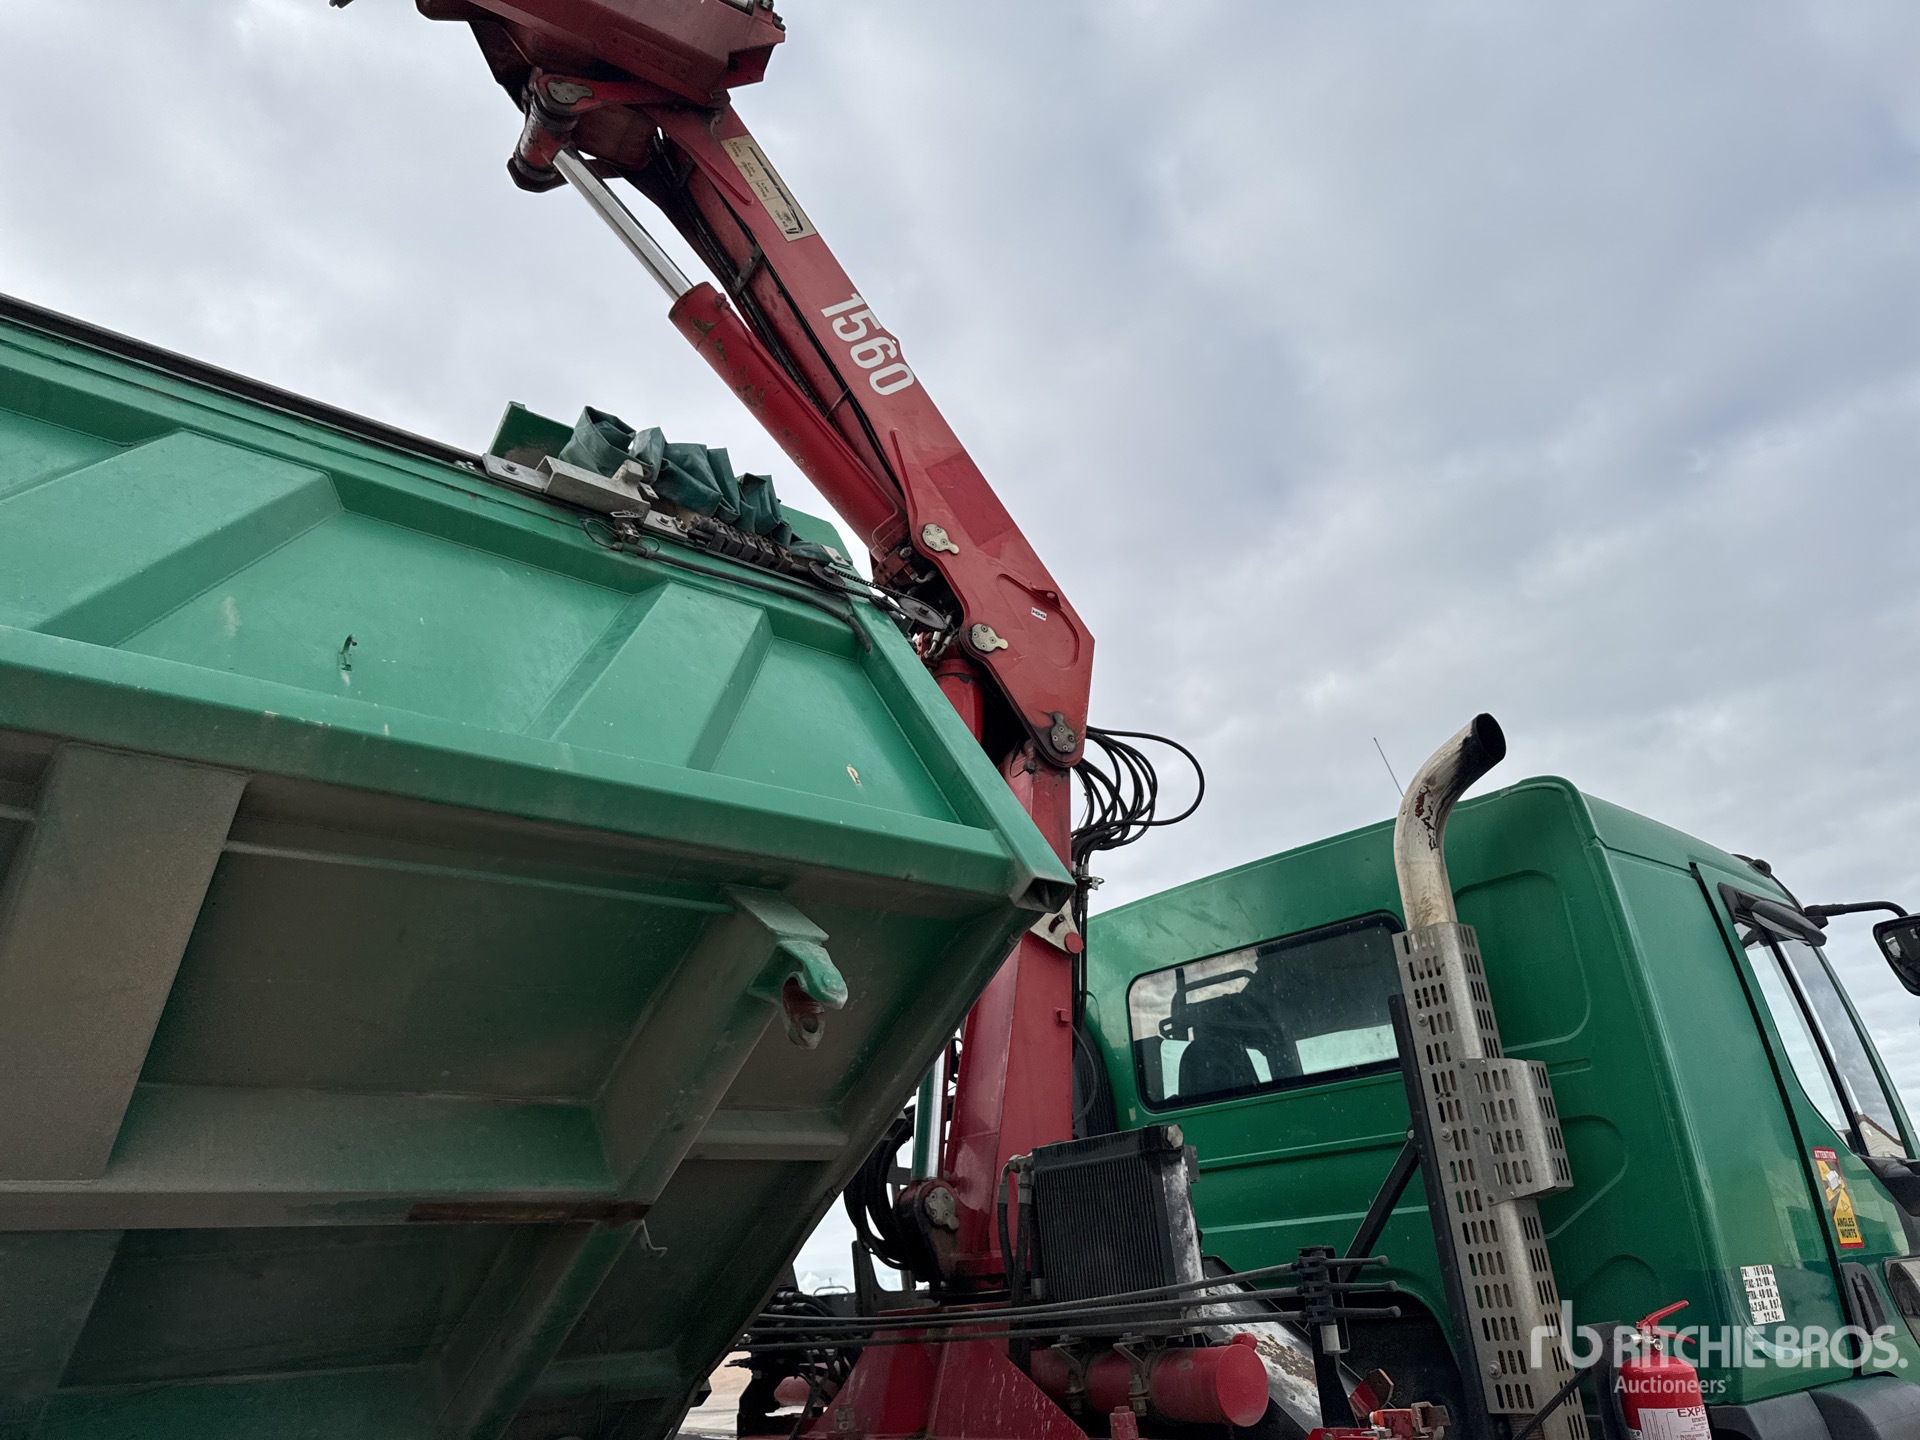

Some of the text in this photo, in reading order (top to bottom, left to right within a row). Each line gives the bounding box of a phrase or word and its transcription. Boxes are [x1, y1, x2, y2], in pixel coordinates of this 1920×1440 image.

[820, 293, 914, 395] 1560
[1814, 1149, 1837, 1160] ATTENTION
[1836, 1217, 1855, 1228] ANGLES
